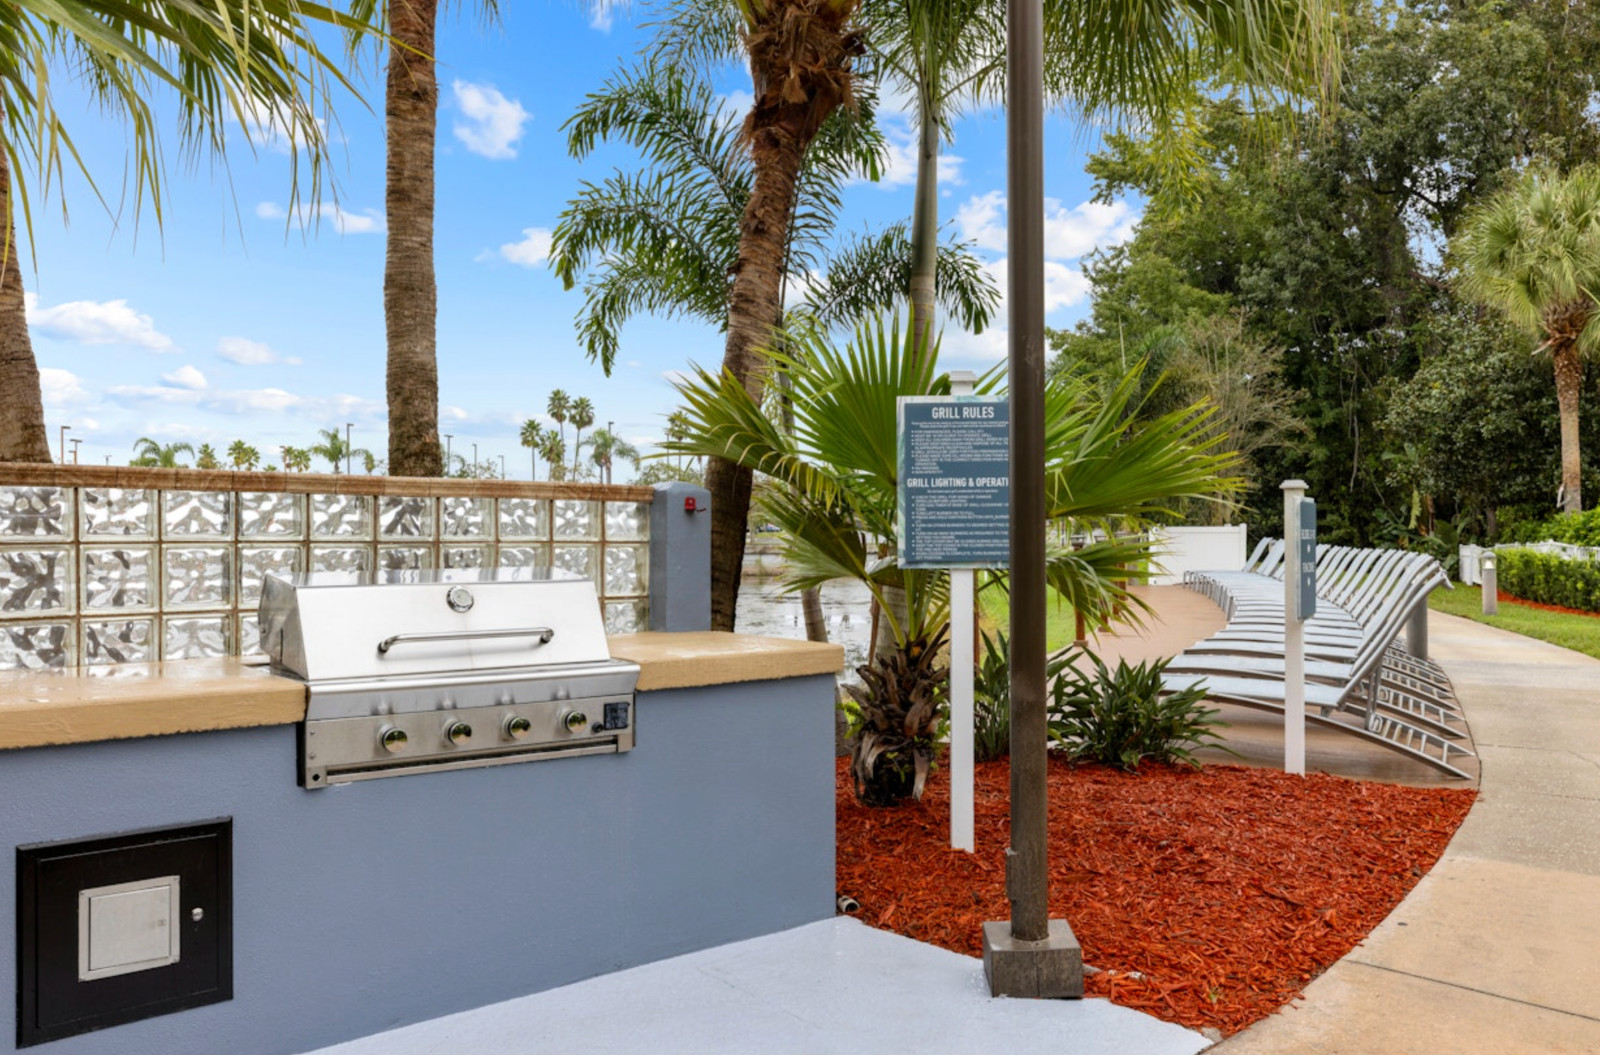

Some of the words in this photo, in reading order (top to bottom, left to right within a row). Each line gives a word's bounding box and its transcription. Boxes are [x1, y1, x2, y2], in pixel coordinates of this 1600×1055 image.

[932, 407, 960, 419] GRILL
[963, 406, 995, 418] RULES
[907, 478, 929, 487] GRILL
[931, 478, 967, 487] LIGHTING
[968, 477, 975, 487] &
[976, 477, 1009, 487] OPERATI
